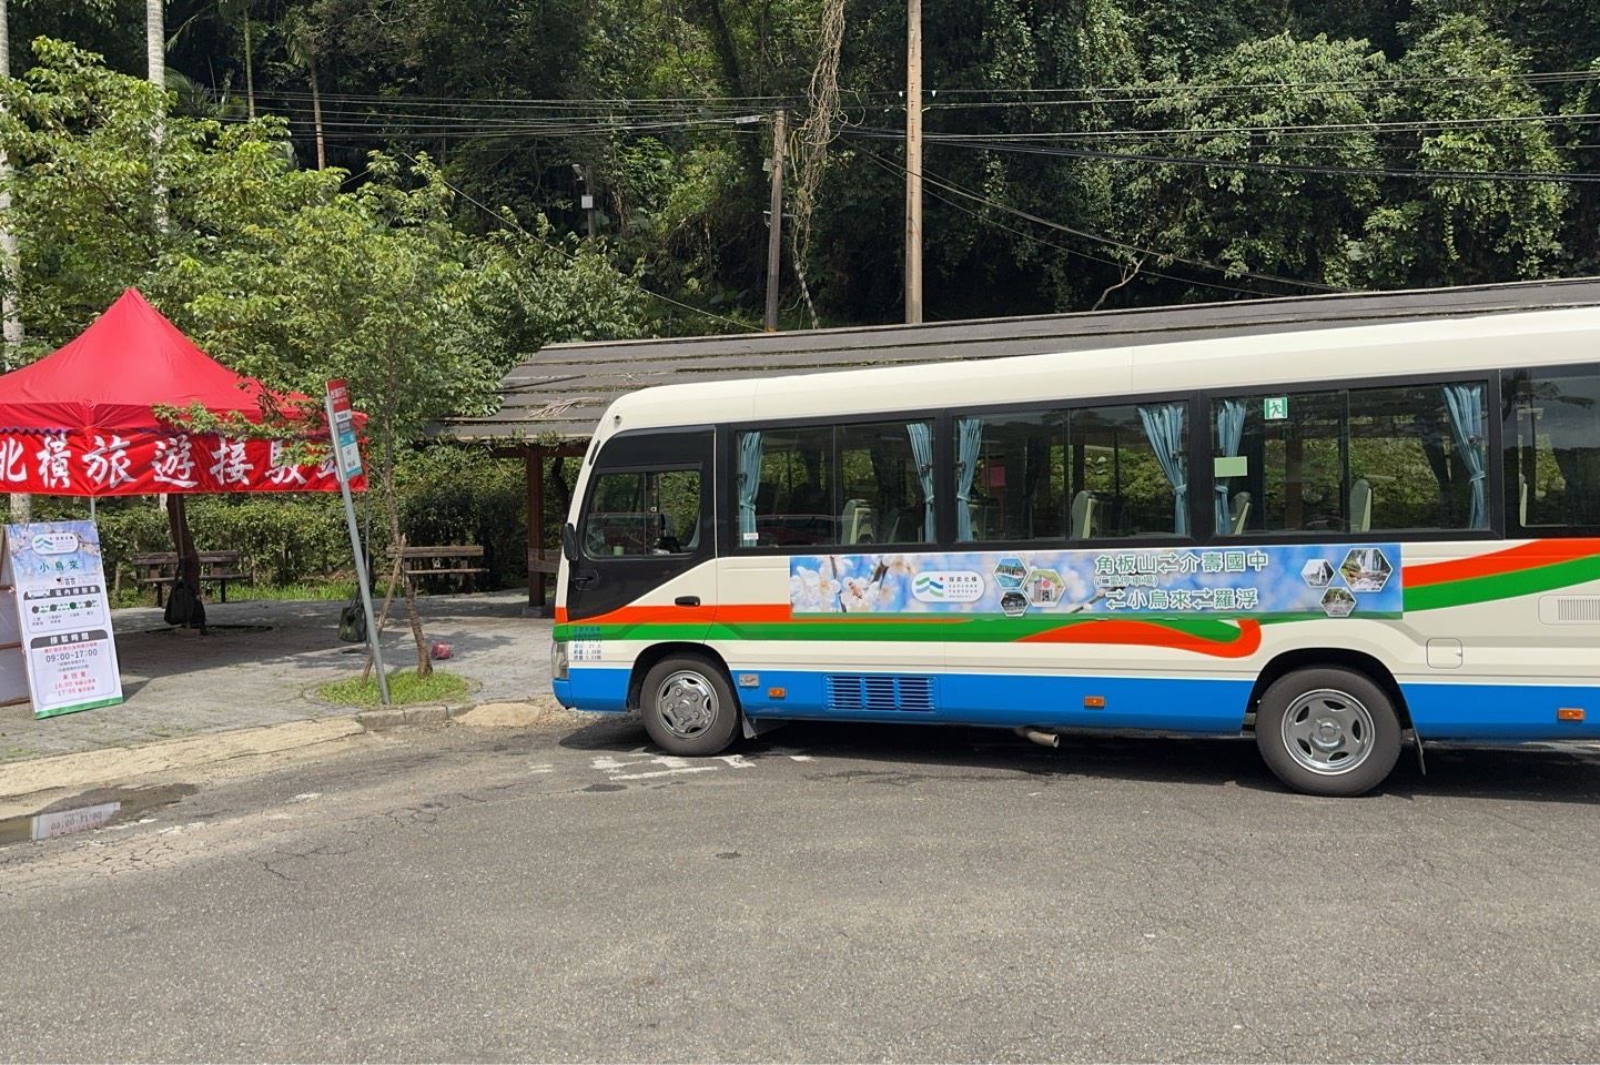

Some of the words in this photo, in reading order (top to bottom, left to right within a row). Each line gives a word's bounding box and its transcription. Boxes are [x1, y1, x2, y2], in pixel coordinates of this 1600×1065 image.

[0, 434, 343, 489] 北橫旅遊接駁
[1095, 553, 1157, 575] 角板山
[1180, 550, 1268, 574] 介壽國中
[1214, 588, 1258, 609] 羅浮
